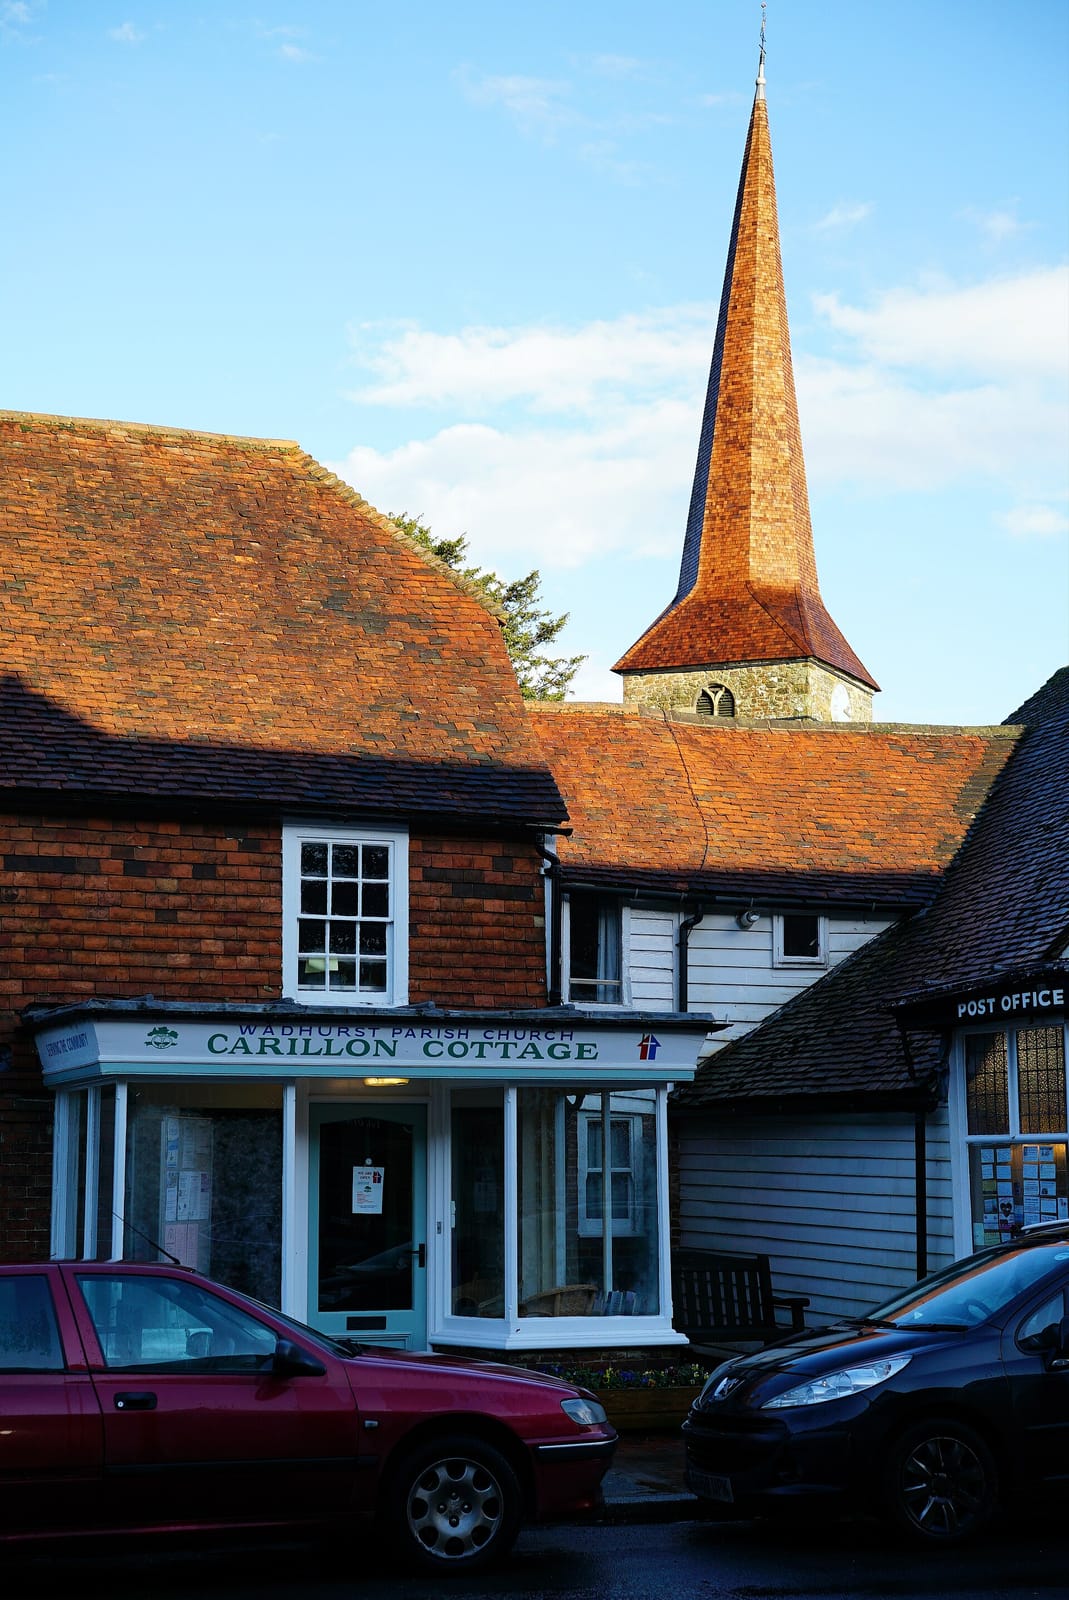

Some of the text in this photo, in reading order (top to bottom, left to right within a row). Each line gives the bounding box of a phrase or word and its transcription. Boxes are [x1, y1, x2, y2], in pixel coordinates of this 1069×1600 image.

[957, 989, 1065, 1018] POST OFFICE
[207, 1033, 599, 1061] CARILLON COTTAGE
[239, 1024, 574, 1042] WADHURST PARISH CHURCH
